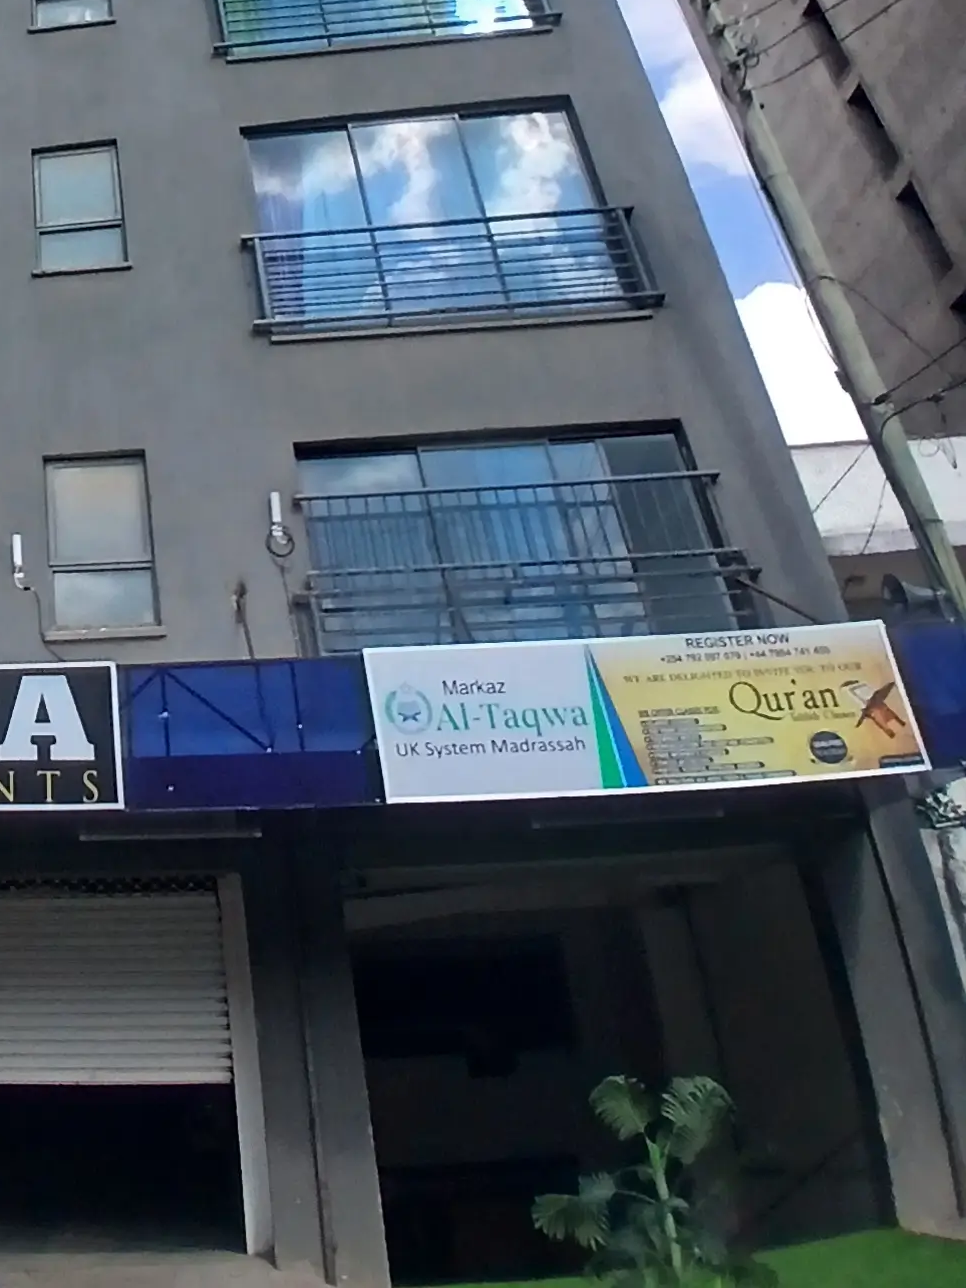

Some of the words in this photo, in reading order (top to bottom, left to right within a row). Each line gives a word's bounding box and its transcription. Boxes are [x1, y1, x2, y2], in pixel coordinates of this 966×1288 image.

[685, 635, 753, 649] REGISTER
[756, 632, 790, 645] NOW
[442, 680, 506, 695] Markaz
[437, 701, 589, 737] Al-Taqwa
[395, 742, 420, 757] UK
[425, 741, 486, 759] System
[491, 736, 586, 755] Madrassah
